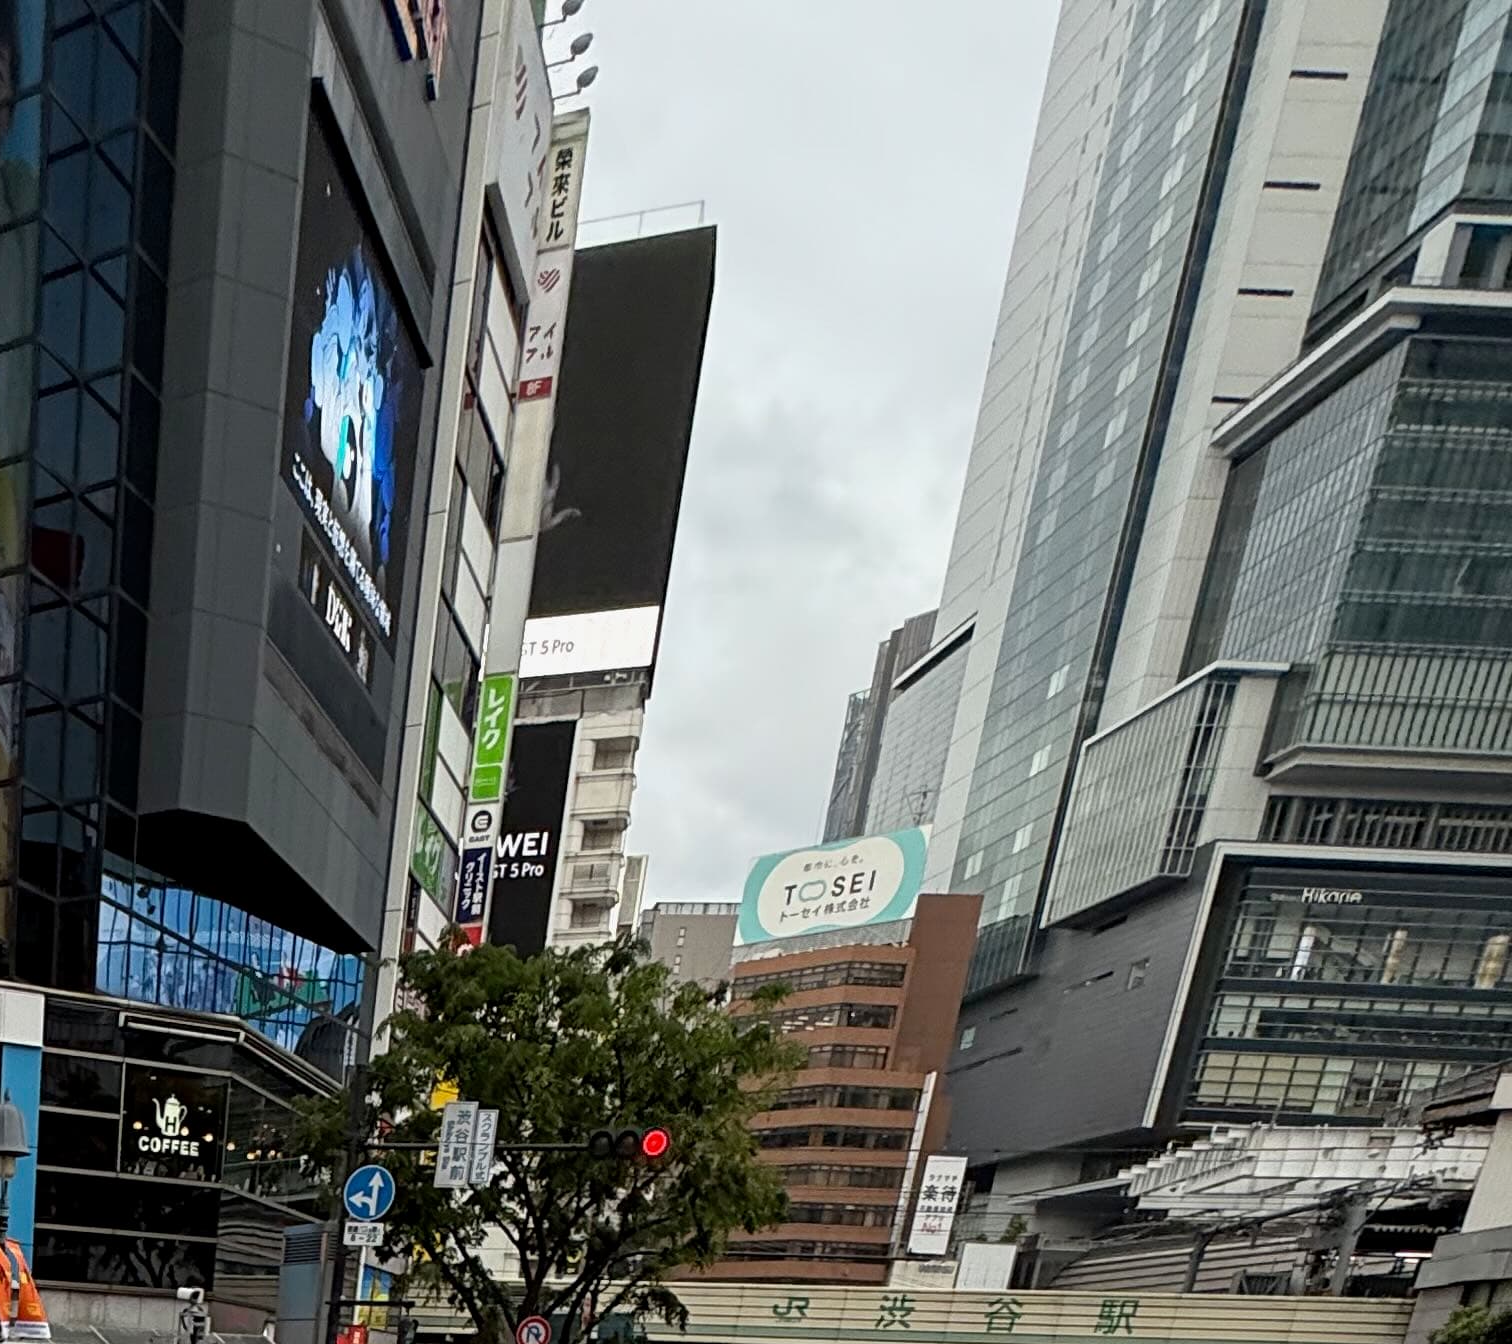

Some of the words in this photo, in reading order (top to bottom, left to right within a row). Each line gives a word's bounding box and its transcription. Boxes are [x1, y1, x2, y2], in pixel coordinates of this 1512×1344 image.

[542, 640, 549, 654] 5
[553, 639, 575, 653] Pro
[482, 688, 505, 750] レイク
[496, 831, 549, 858] WEI
[510, 864, 518, 877] 5
[521, 862, 545, 877] Pro
[1301, 887, 1364, 904] Hikarie
[779, 897, 871, 924] トーセイ株式会社
[138, 1135, 200, 1158] COFFEE
[449, 1110, 472, 1182] 渋谷駅前
[922, 1184, 958, 1203] 楽待
[772, 1296, 810, 1316] JR
[874, 1294, 1140, 1335] 渋谷駅
